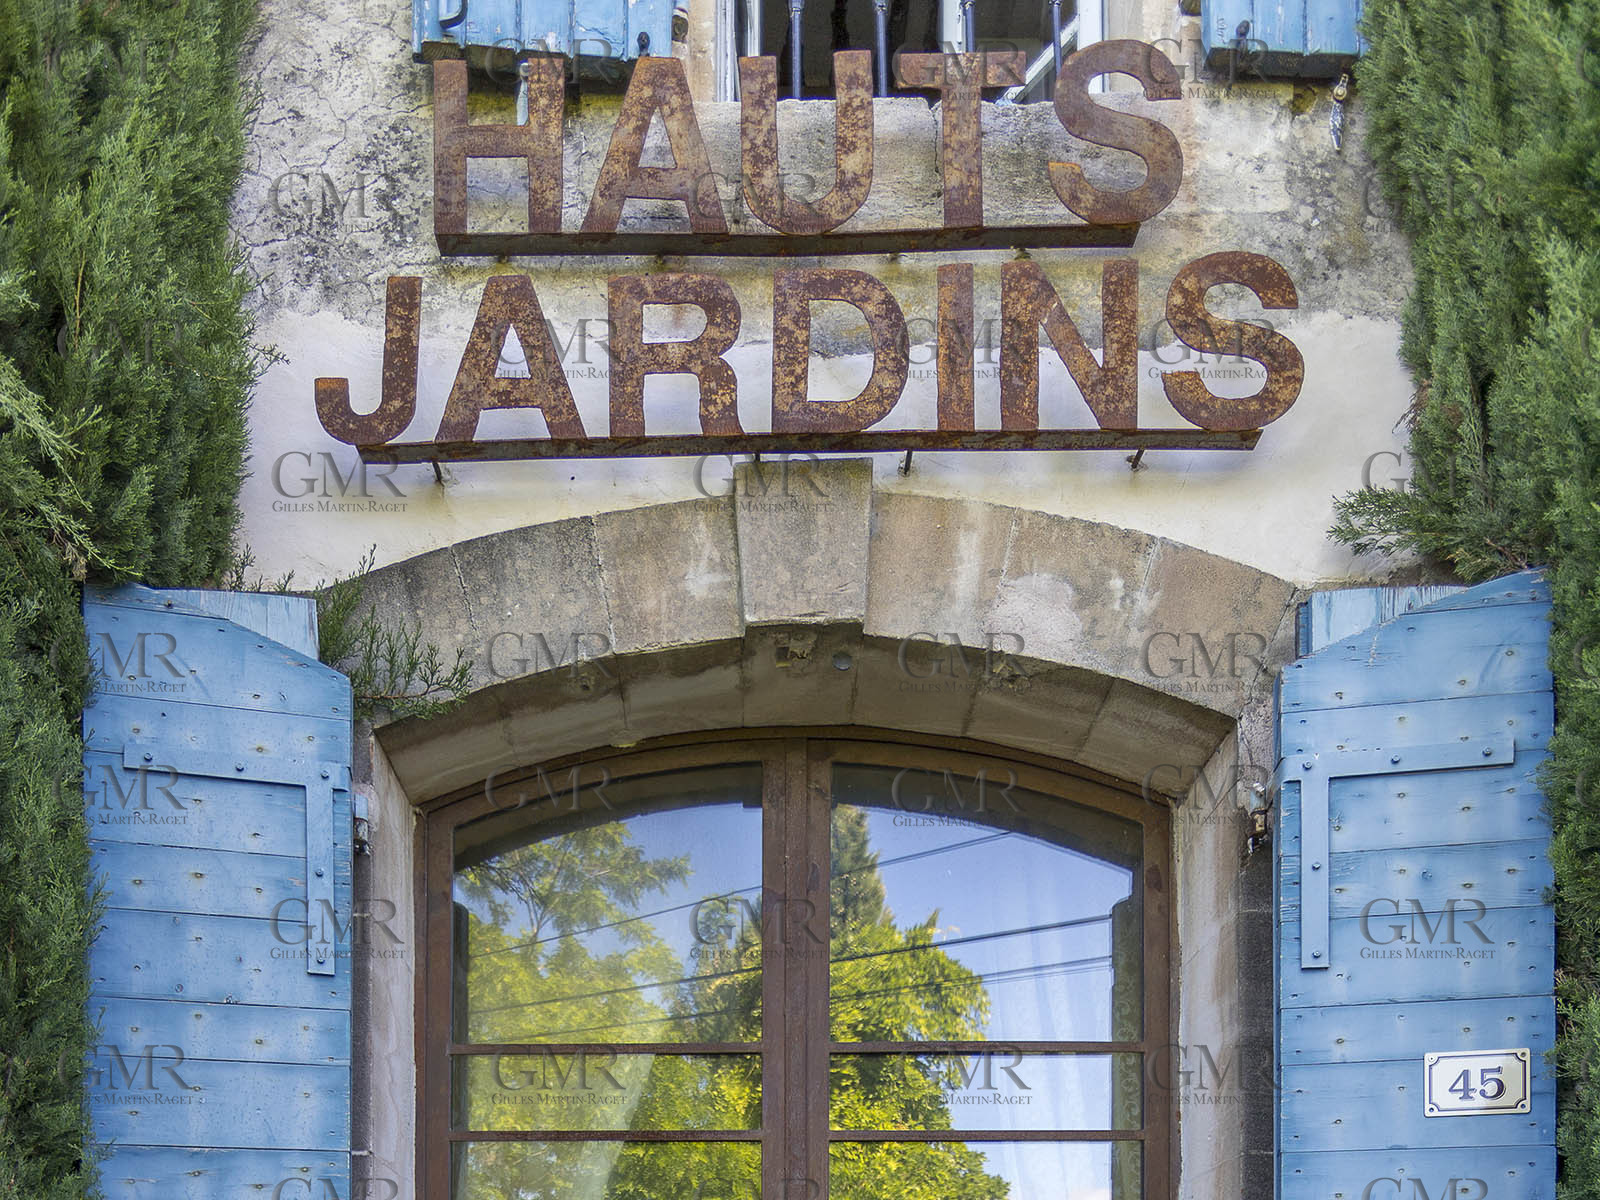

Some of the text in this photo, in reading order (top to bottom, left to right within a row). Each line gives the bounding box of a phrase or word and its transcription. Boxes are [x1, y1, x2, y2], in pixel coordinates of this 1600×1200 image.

[433, 39, 1183, 236] HAUTS
[315, 251, 1304, 446] JARDINS
[1448, 1066, 1506, 1100] 45
